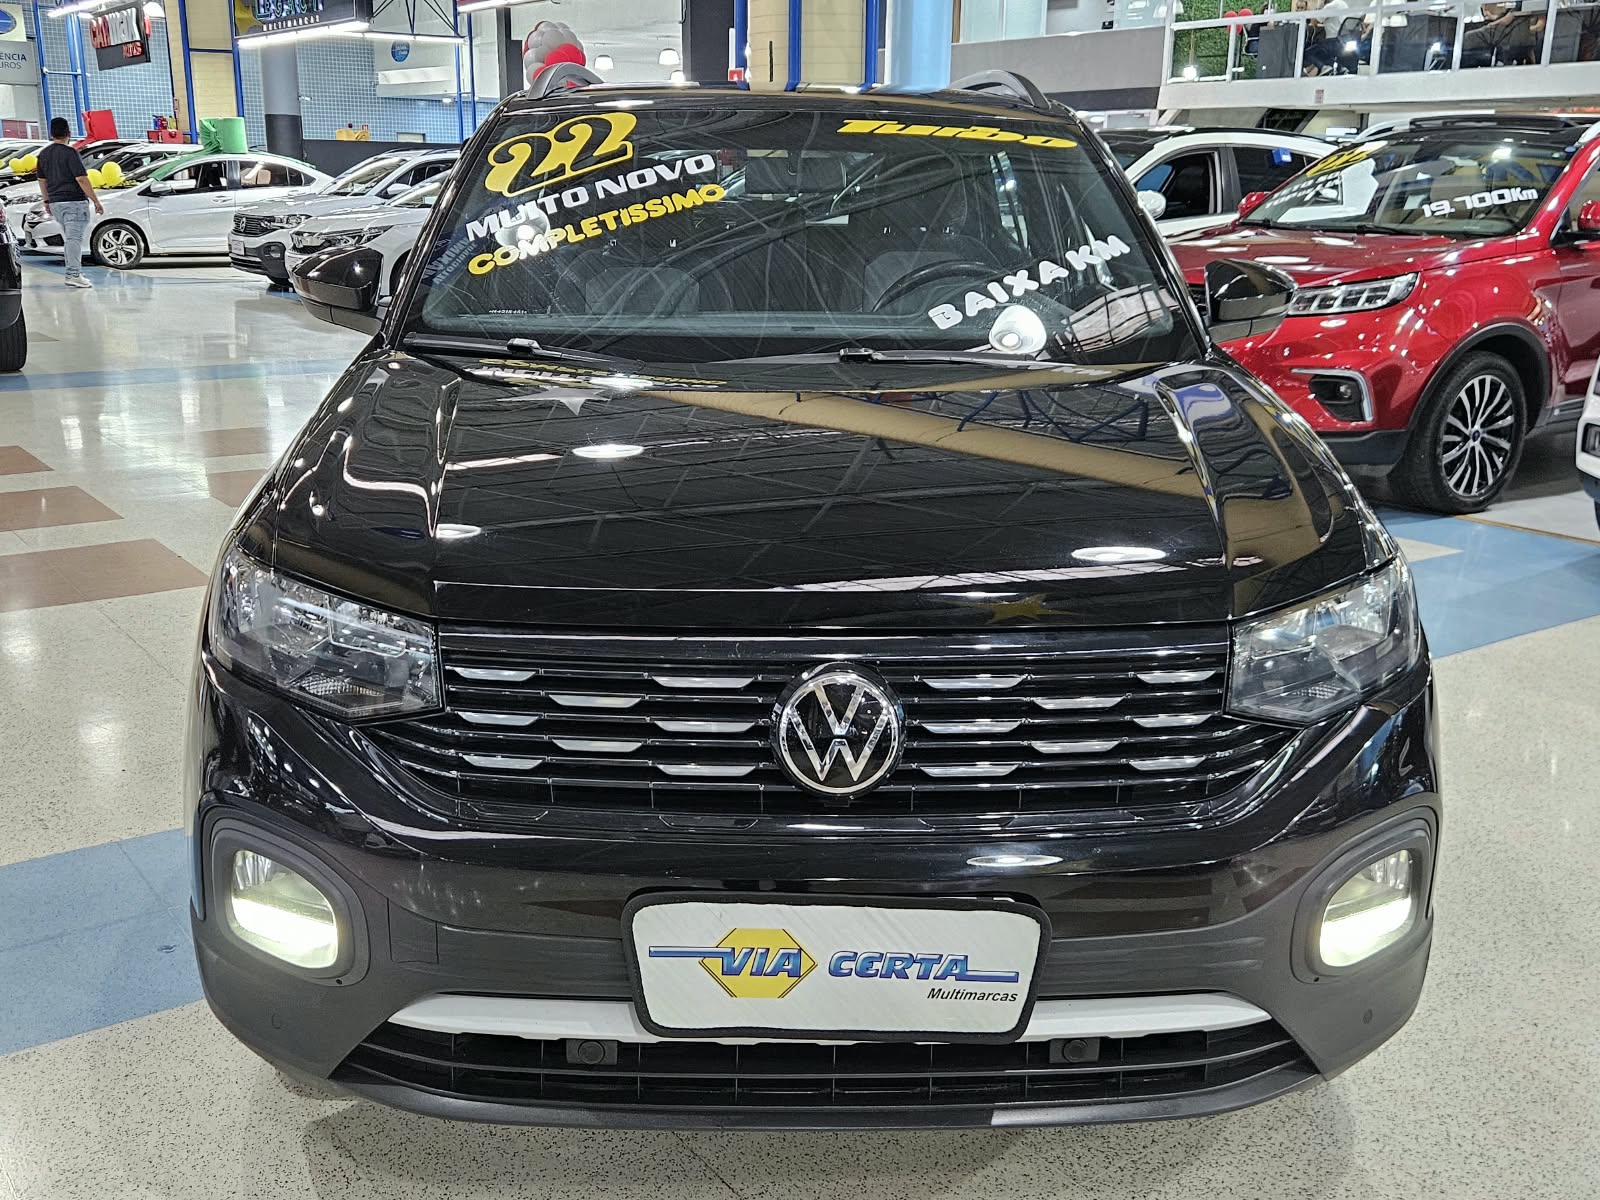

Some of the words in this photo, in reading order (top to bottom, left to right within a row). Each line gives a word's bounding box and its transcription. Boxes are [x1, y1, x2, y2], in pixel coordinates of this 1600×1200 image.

[484, 112, 637, 197] 22
[465, 186, 589, 241] MUITO
[595, 154, 716, 199] NOVO
[720, 946, 803, 978] VIA
[828, 950, 969, 982] CERTA
[926, 987, 1019, 1002] Multimarcas
